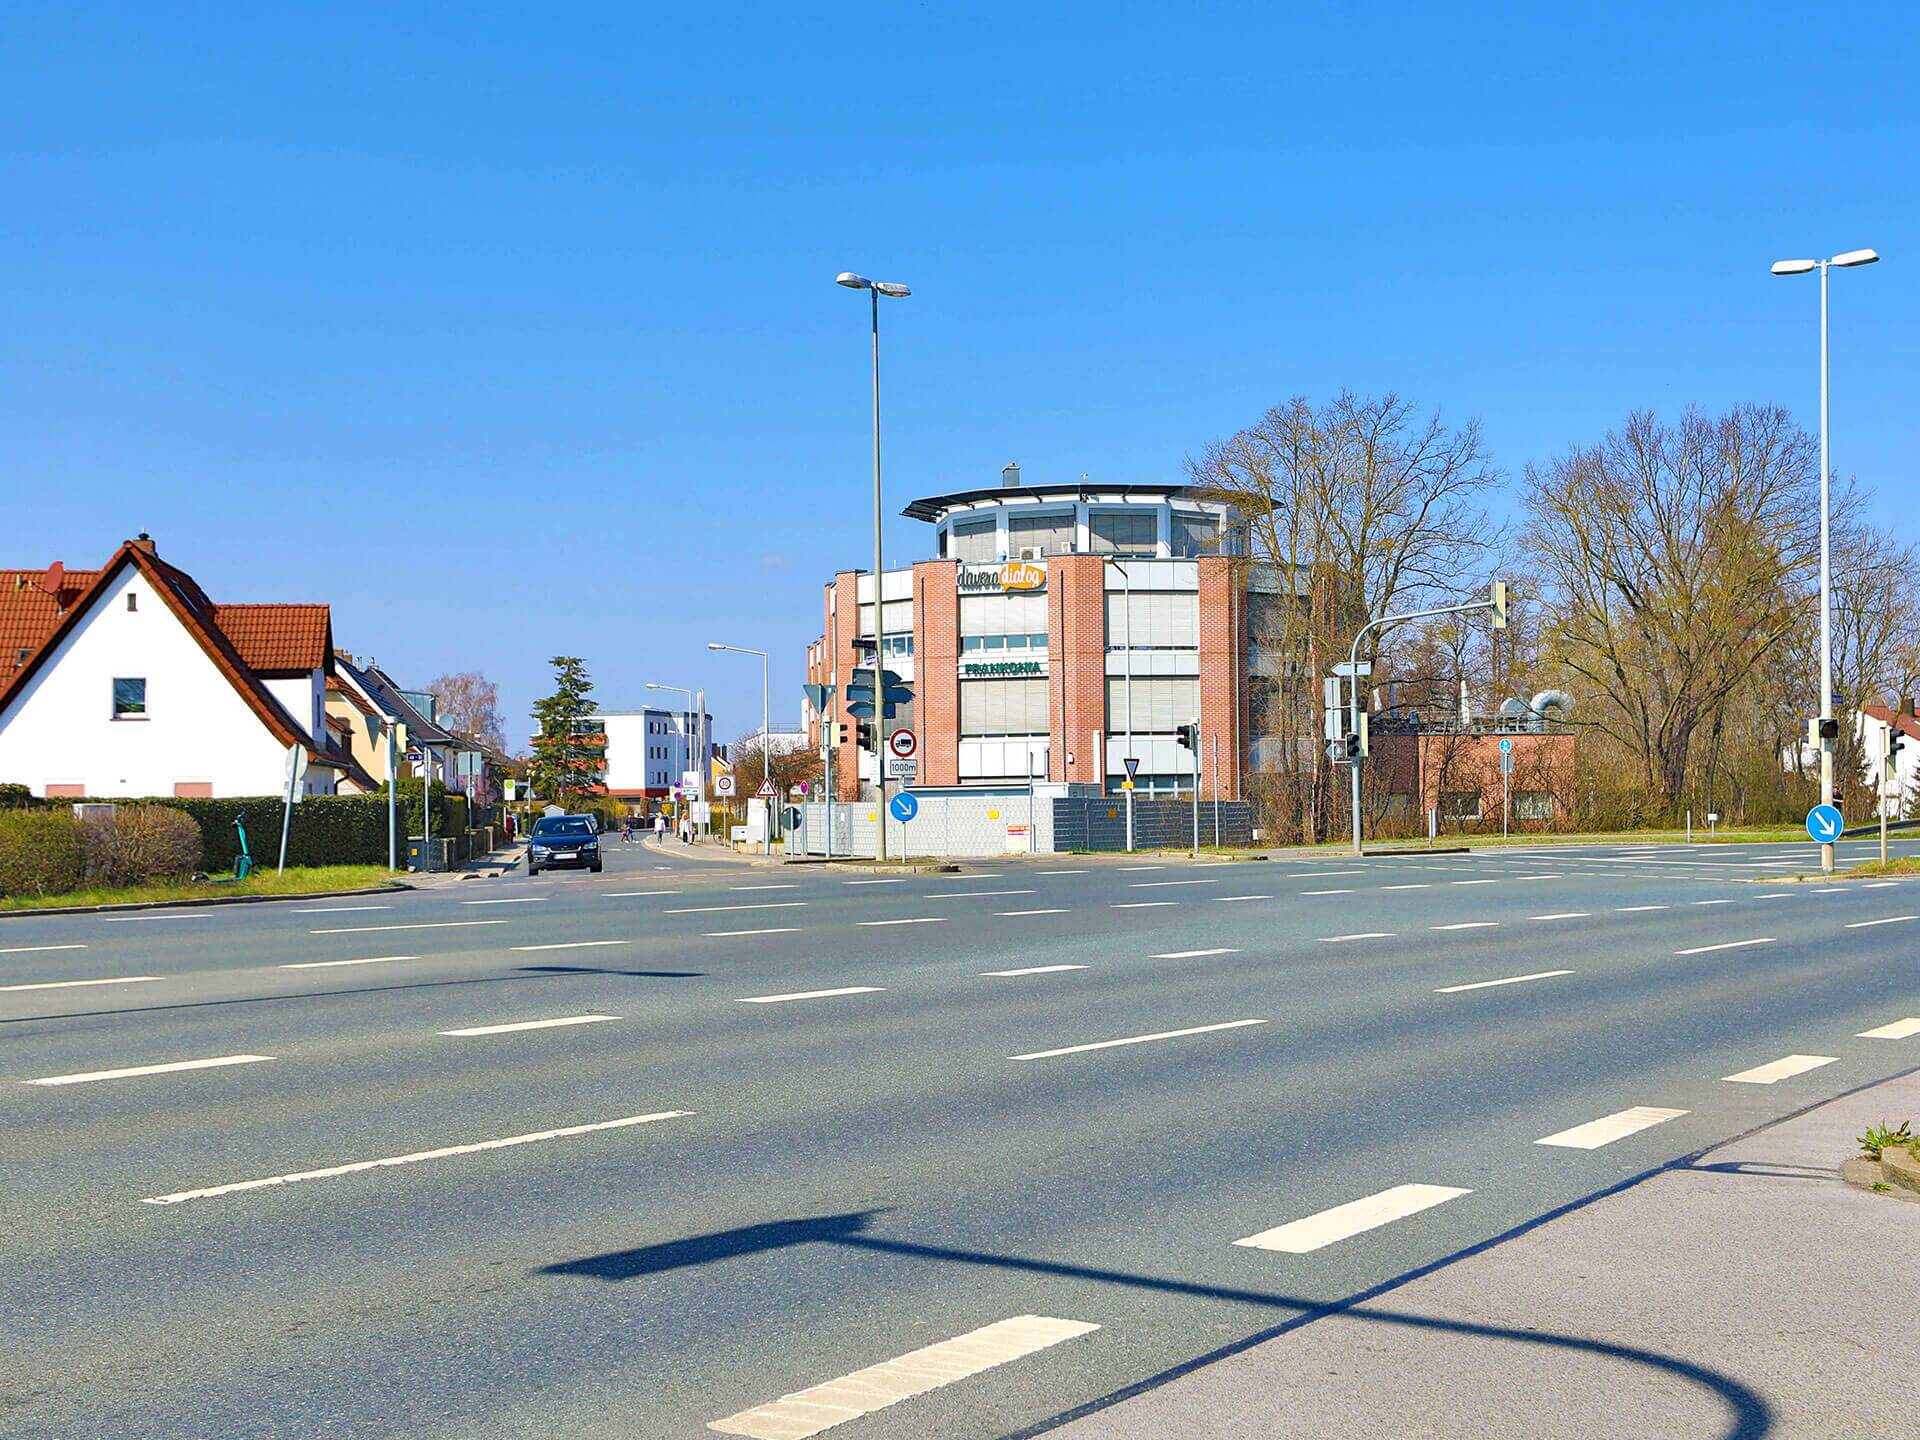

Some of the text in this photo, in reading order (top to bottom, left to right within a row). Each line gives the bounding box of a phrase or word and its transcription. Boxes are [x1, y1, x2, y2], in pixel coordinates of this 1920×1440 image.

[1001, 564, 1039, 586] dialog
[965, 661, 1041, 674] FRANKONIA
[892, 763, 916, 772] 1000m
